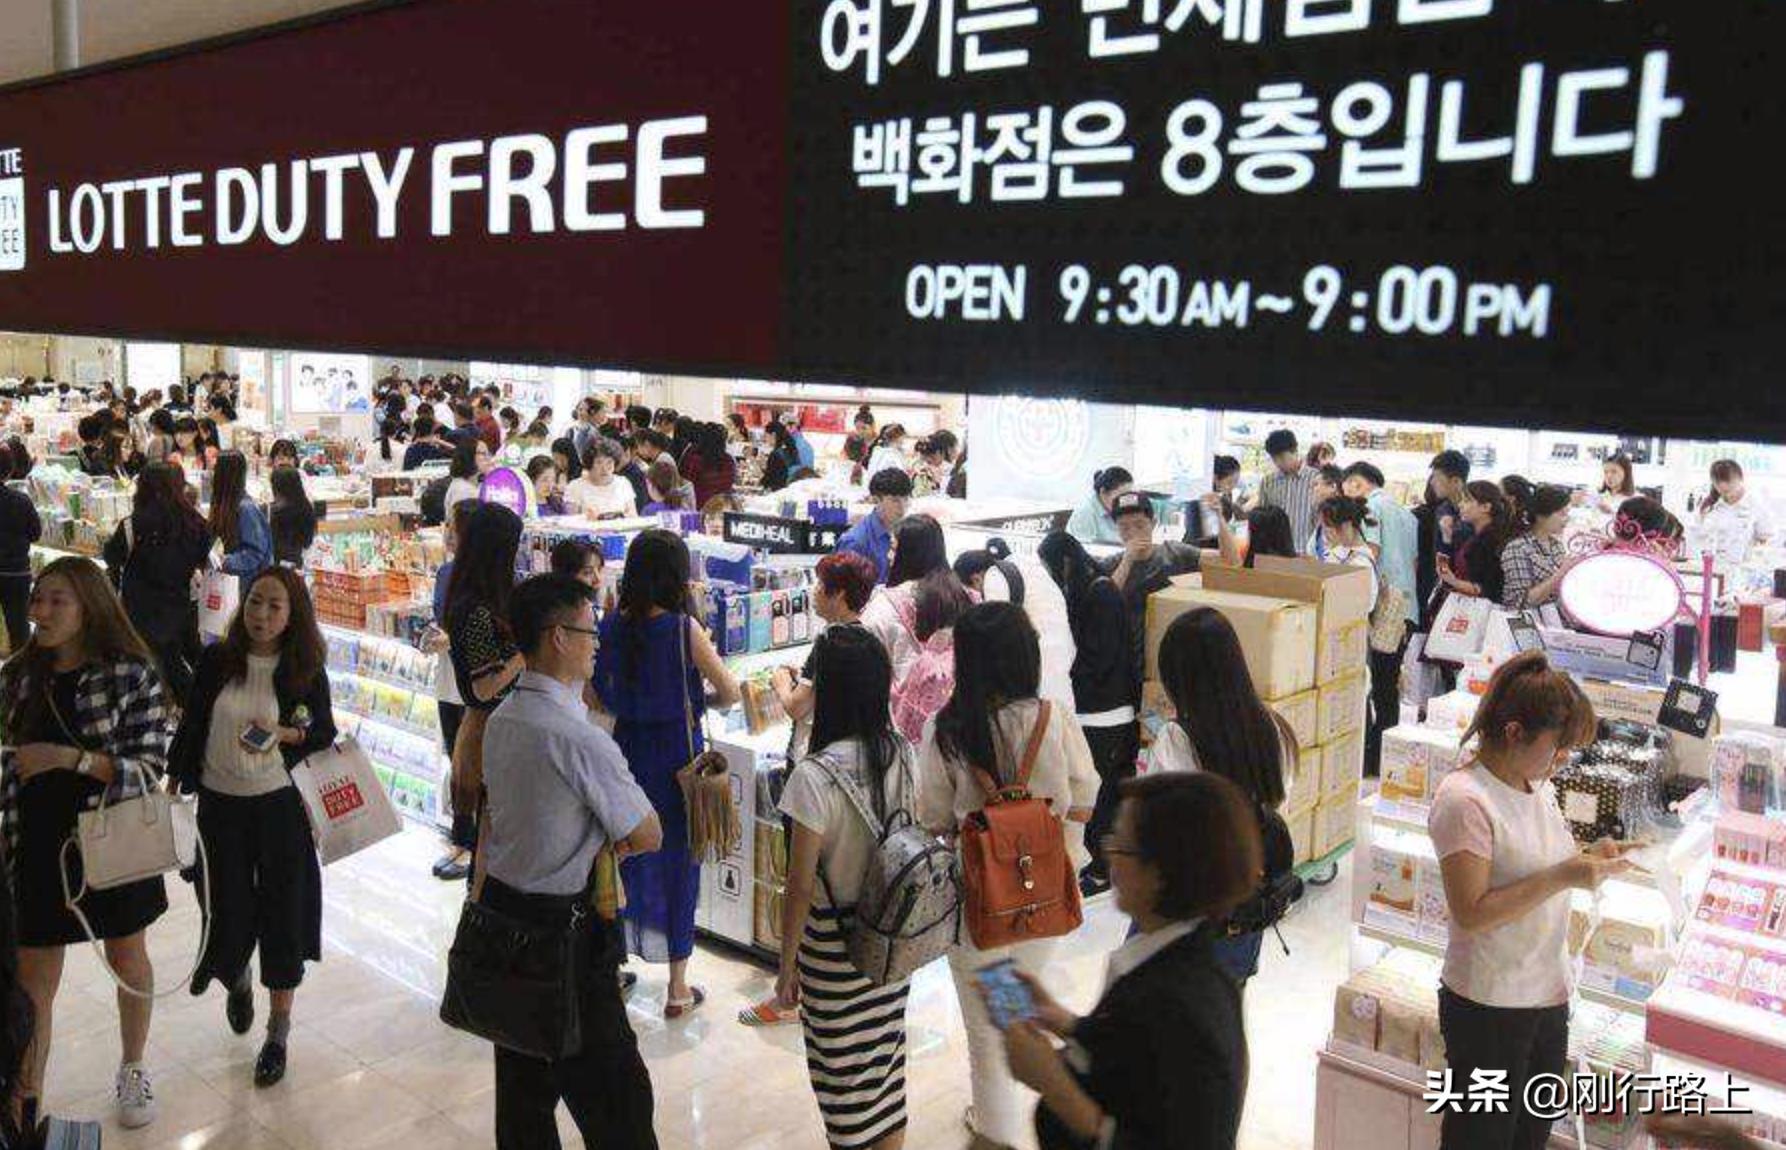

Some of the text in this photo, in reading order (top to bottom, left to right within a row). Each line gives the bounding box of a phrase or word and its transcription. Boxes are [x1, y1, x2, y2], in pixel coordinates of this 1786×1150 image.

[821, 0, 1038, 84] 여기는
[853, 51, 1682, 205] 백화점은 8층입니다
[49, 116, 707, 252] LOTTE DUTY FREE
[906, 265, 1025, 322] OPEN
[730, 521, 794, 545] MEDIHEAL
